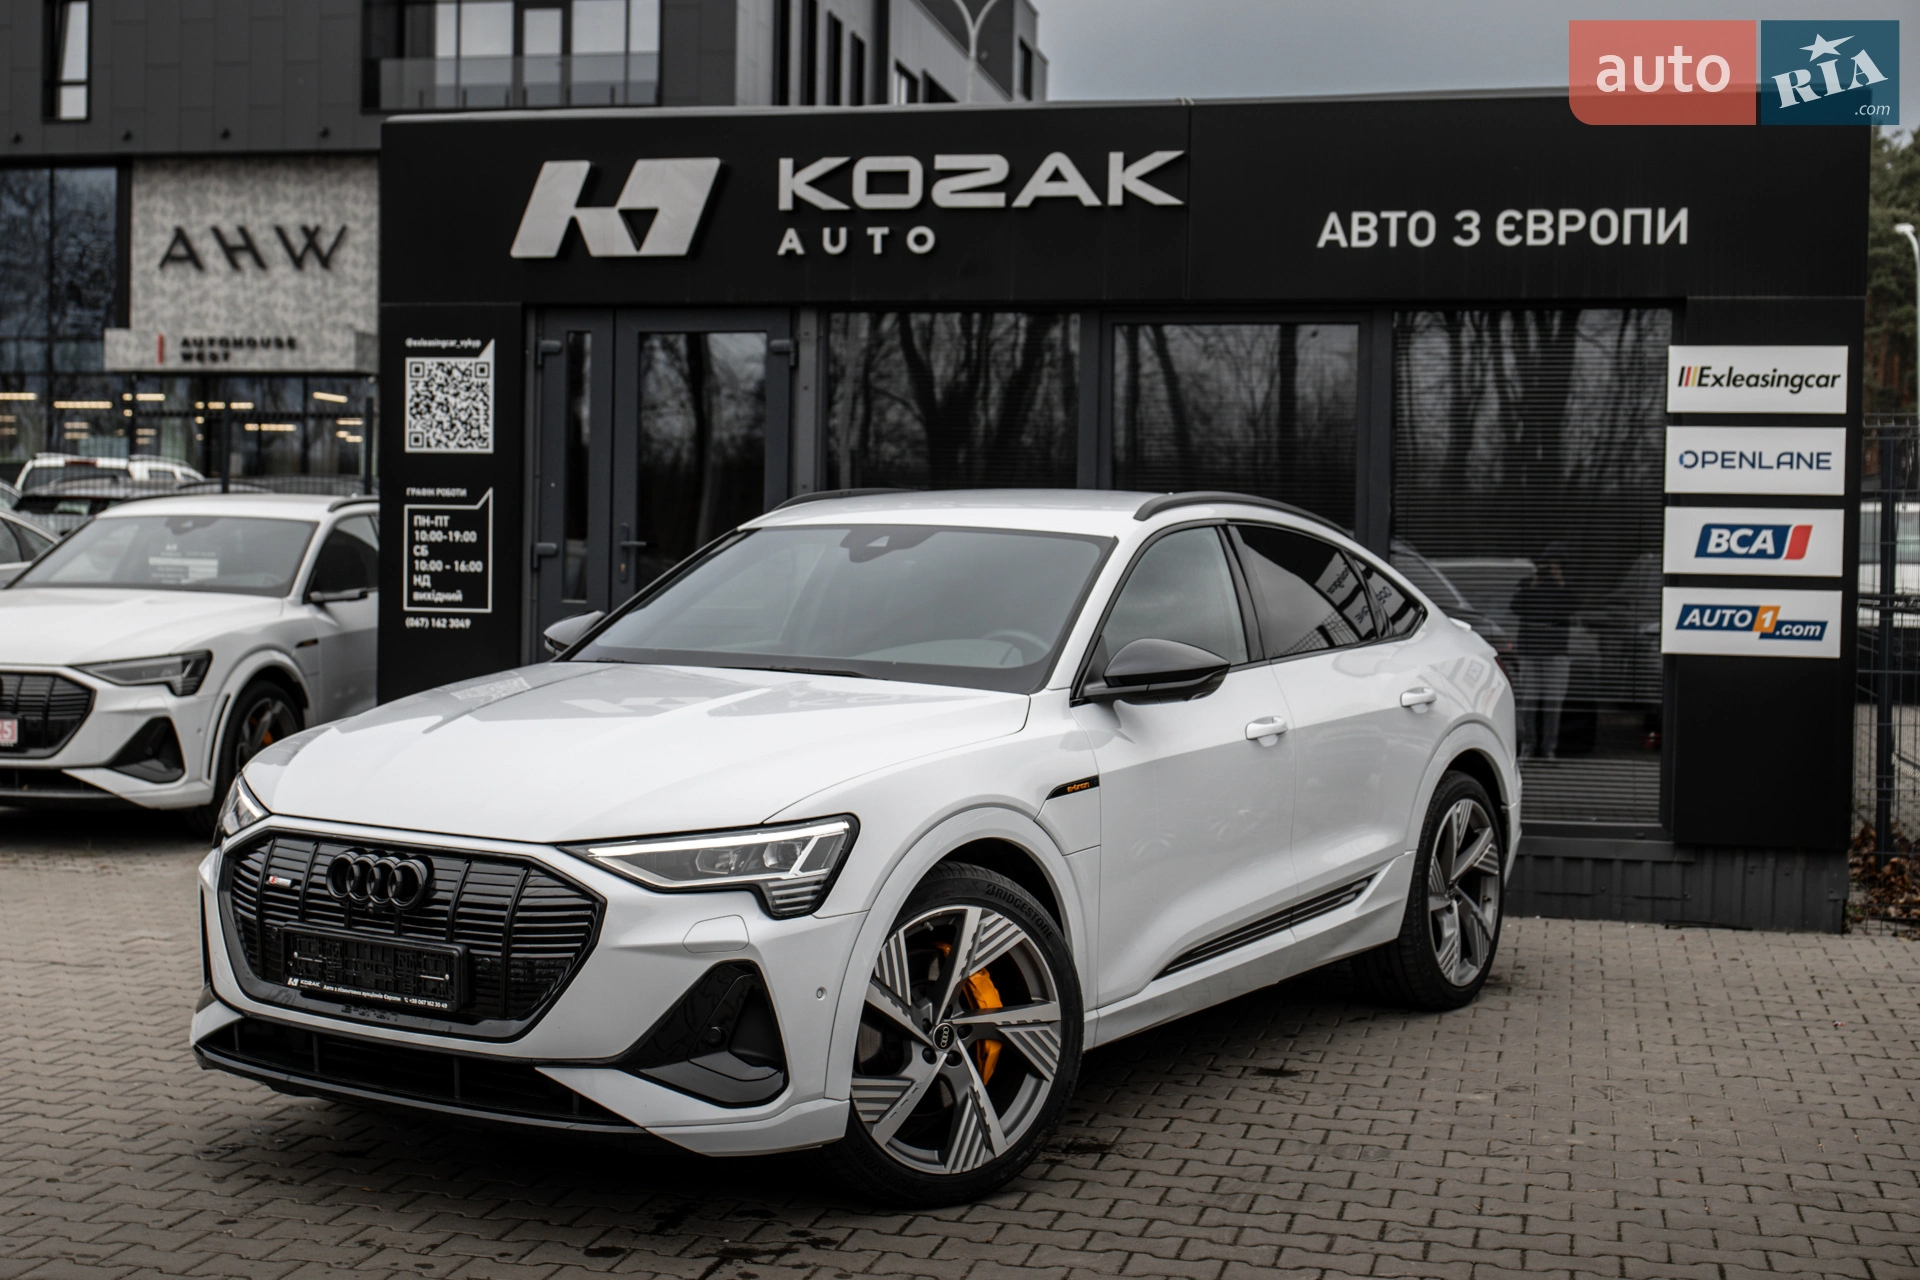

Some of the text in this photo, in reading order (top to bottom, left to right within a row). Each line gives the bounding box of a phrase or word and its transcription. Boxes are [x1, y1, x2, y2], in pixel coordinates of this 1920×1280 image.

[778, 151, 1186, 210] KOZAK
[1317, 207, 1689, 248] АВТО З ЄВРОПИ
[778, 226, 935, 255] AUTO
[159, 225, 347, 272] AHW
[181, 336, 297, 350] AUTOHOUSE
[181, 351, 230, 362] WEST
[1697, 366, 1841, 394] Exleasingcar
[1679, 450, 1832, 470] OPENLANE
[413, 515, 451, 528] ПН-ПТ
[414, 529, 478, 543] 10:00-19:00
[1706, 528, 1776, 555] BCA
[413, 545, 430, 557] СБ
[414, 559, 443, 572] 10:00
[454, 560, 483, 573] 16:00
[413, 574, 432, 588] НД
[413, 589, 463, 603] вихідний
[985, 883, 1054, 940] BRIDGESTONE
[300, 979, 320, 987] KOZAK
